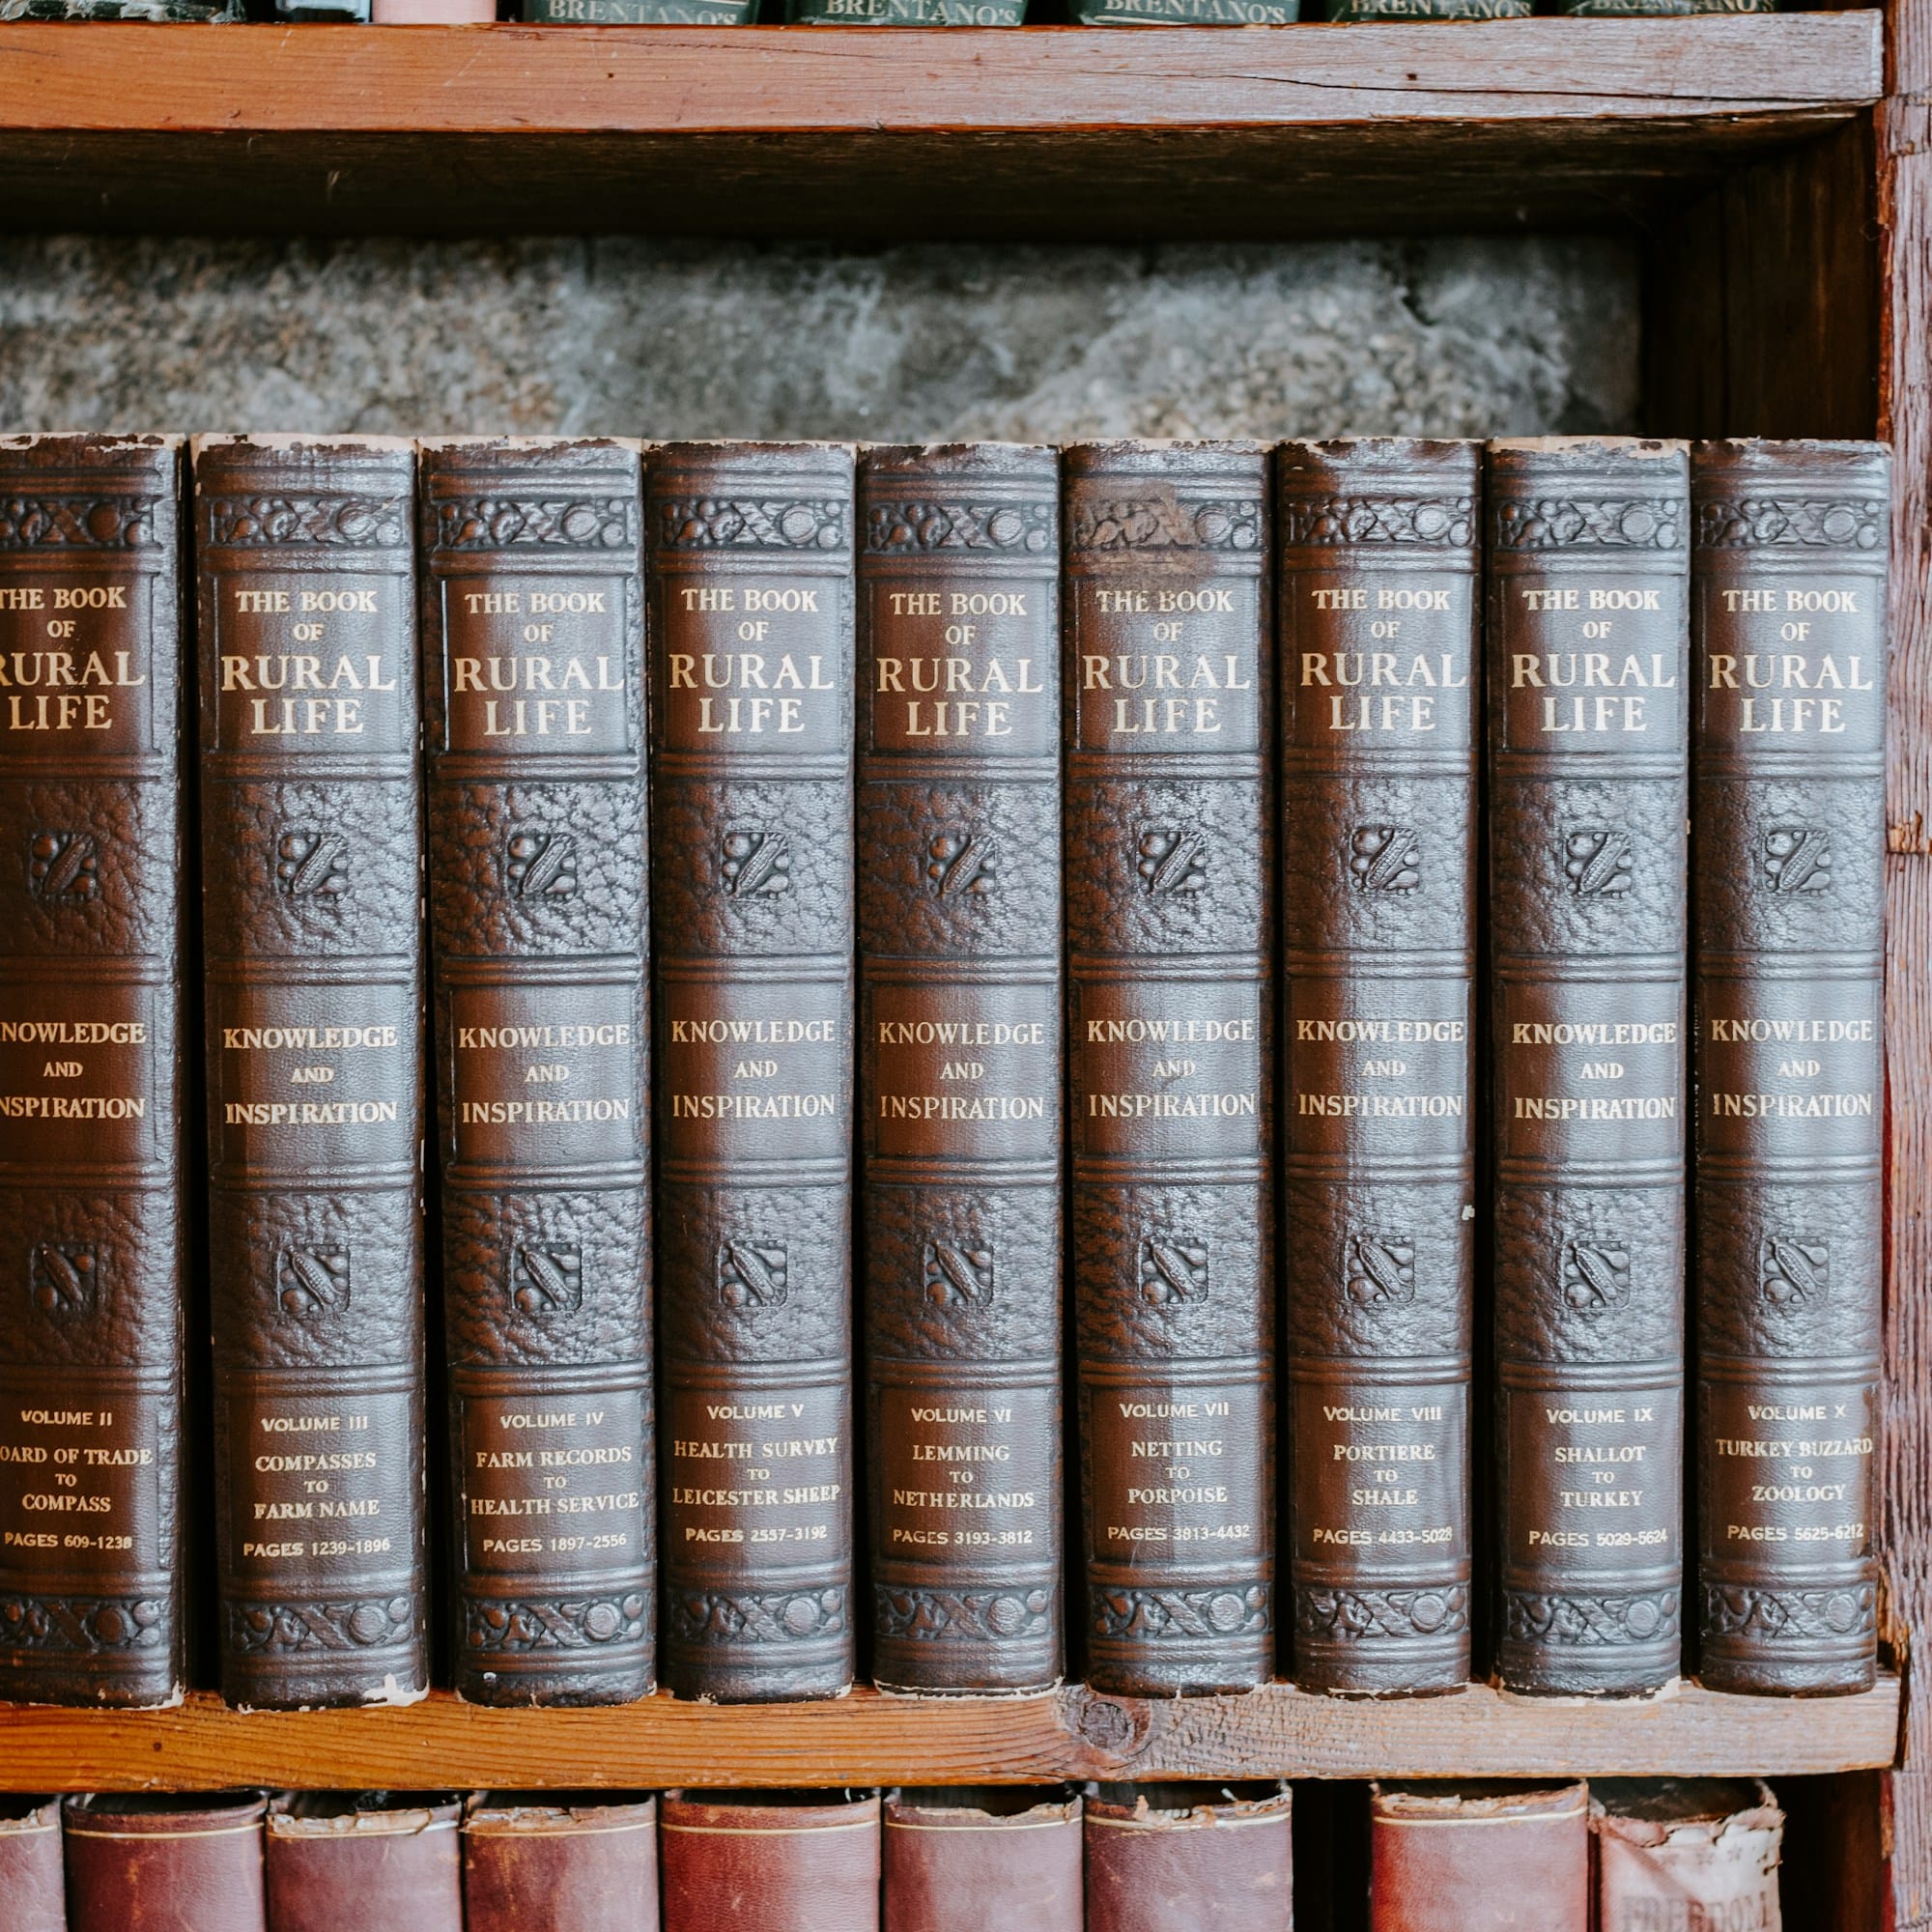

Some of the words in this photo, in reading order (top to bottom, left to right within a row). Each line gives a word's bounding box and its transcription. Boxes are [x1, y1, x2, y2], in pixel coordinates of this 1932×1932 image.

[0, 588, 44, 610] THE
[53, 586, 127, 609] BOOK
[236, 591, 290, 612] THE
[301, 590, 378, 612] BOOK
[465, 593, 520, 614] THE
[530, 591, 605, 613] BOOK
[681, 589, 734, 611] THE
[744, 589, 818, 612] BOOK
[890, 593, 942, 614] THE
[952, 594, 1027, 616] BOOK
[1095, 590, 1149, 611] THE
[1158, 589, 1234, 612] BOOK
[1312, 589, 1368, 611] THE
[1378, 589, 1451, 611] BOOK
[1522, 589, 1578, 611] THE
[1589, 589, 1660, 611] BOOK
[1721, 589, 1776, 611] THE
[1785, 590, 1857, 612] BOOK
[47, 620, 76, 638] OF
[294, 624, 323, 641] OF
[524, 624, 553, 641] OF
[739, 621, 768, 640] OF
[946, 625, 975, 645] OF
[1153, 622, 1182, 641] OF
[1371, 620, 1400, 639] OF
[1582, 621, 1612, 639] OF
[1781, 622, 1809, 641] OF
[220, 654, 396, 691] RURAL
[454, 656, 624, 692] RURAL
[669, 654, 834, 690] RURAL
[877, 657, 1043, 693] RURAL
[1082, 654, 1250, 690] RURAL
[1299, 652, 1467, 688] RURAL
[1511, 653, 1675, 689] RURAL
[1709, 654, 1873, 690] RURAL
[8, 695, 112, 729] LIFE
[251, 698, 364, 734] LIFE
[484, 699, 591, 735] LIFE
[698, 697, 806, 733] LIFE
[906, 700, 1012, 736] LIFE
[1114, 697, 1221, 733] LIFE
[1329, 695, 1435, 730] LIFE
[1541, 695, 1647, 731] LIFE
[1740, 697, 1845, 732] LIFE
[0, 1022, 147, 1043] NOWLEDGE
[223, 1027, 398, 1049] KNOWLEDGE
[459, 1024, 630, 1049] KNOWLEDGE
[671, 1020, 835, 1043] KNOWLEDGE
[879, 1022, 1044, 1045] KNOWLEDGE
[1087, 1019, 1255, 1042] KNOWLEDGE
[1296, 1019, 1464, 1042] KNOWLEDGE
[1512, 1022, 1677, 1045] KNOWLEDGE
[1711, 1019, 1872, 1042] KNOWLEDGE
[43, 1062, 83, 1077] AND
[290, 1066, 334, 1083] AND
[525, 1065, 569, 1082] AND
[734, 1061, 778, 1078] AND
[940, 1063, 983, 1080] AND
[1151, 1060, 1195, 1077] AND
[1362, 1060, 1406, 1077] AND
[1580, 1063, 1623, 1080] AND
[1777, 1060, 1820, 1077] AND
[0, 1096, 146, 1119] NSPIRATION
[225, 1101, 397, 1124] INSPIRATION
[462, 1099, 629, 1123] INSPIRATION
[672, 1094, 835, 1119] INSPIRATION
[880, 1095, 1044, 1120] INSPIRATION
[1089, 1093, 1255, 1118] INSPIRATION
[1298, 1094, 1463, 1117] INSPIRATION
[1515, 1096, 1676, 1120] INSPIRATION
[1712, 1093, 1872, 1118] INSPIRATION
[21, 1410, 93, 1426] VOLUME
[100, 1412, 112, 1426] II
[707, 1406, 784, 1419] VOLUME
[791, 1405, 804, 1417] V
[911, 1408, 986, 1422] VOLUME
[995, 1409, 1011, 1422] VI
[1120, 1404, 1198, 1418] VOLUME
[1206, 1402, 1229, 1416] VII
[1323, 1406, 1402, 1422] VOLUME
[1411, 1406, 1441, 1420] VIII
[1547, 1409, 1625, 1424] VOLUME
[1634, 1408, 1654, 1422] IX
[1747, 1406, 1826, 1420] VOLUME
[1835, 1406, 1846, 1417] X
[262, 1417, 340, 1432] VOLUME
[350, 1416, 368, 1430] III
[500, 1413, 576, 1429] VOLUME
[585, 1412, 604, 1426] IV
[0, 1446, 47, 1463] OARD
[54, 1449, 79, 1463] OF
[84, 1449, 154, 1464] TRADE
[674, 1440, 753, 1458] HEALTH
[762, 1437, 838, 1458] SURVEY
[913, 1445, 1009, 1462] LEMMING
[1132, 1440, 1222, 1457] NETTING
[1334, 1444, 1435, 1461] PORTIERE
[1555, 1446, 1646, 1463] SHALLOT
[1716, 1439, 1794, 1457] TURKEY
[1799, 1437, 1873, 1457] BUZZARD
[255, 1452, 377, 1471] COMPASSES
[476, 1452, 533, 1467] FARM
[540, 1447, 632, 1466] RECORDS
[55, 1474, 77, 1487] TO
[748, 1468, 770, 1480] TO
[950, 1471, 973, 1483] TO
[1166, 1466, 1190, 1479] TO
[1374, 1470, 1398, 1483] TO
[1592, 1471, 1615, 1484] TO
[1790, 1466, 1812, 1479] TO
[304, 1480, 328, 1492] TO
[544, 1476, 566, 1489] TO
[672, 1488, 779, 1506] LEICESTER
[783, 1485, 841, 1504] SHEEP
[894, 1490, 1034, 1508] NETHERLANDS
[1128, 1487, 1228, 1504] PORPOISE
[1352, 1490, 1419, 1506] SHALE
[1561, 1491, 1643, 1507] TURKEY
[1751, 1484, 1846, 1501] ZOOLOGY
[22, 1494, 111, 1512] COMPASS
[254, 1502, 313, 1520] FARM
[320, 1500, 380, 1518] NAME
[471, 1499, 551, 1516] HEALTH
[557, 1492, 639, 1513] SERVICE
[5, 1532, 58, 1547] PAGES
[65, 1535, 132, 1549] 609-1238
[686, 1528, 743, 1542] PAGES
[751, 1526, 827, 1542] 2557-3192
[894, 1529, 949, 1545] PAGES
[954, 1530, 1033, 1545] 3193-3812
[1108, 1527, 1167, 1541] PAGES
[1173, 1524, 1250, 1540] 3813-4432
[1313, 1529, 1372, 1545] PAGES
[1378, 1527, 1452, 1544] 4433-5028
[1529, 1531, 1589, 1546] PAGES
[1597, 1529, 1668, 1546] 5029-5624
[1727, 1525, 1787, 1541] PAGES
[1794, 1524, 1863, 1541] 5625-6212
[243, 1543, 303, 1557] PAGES
[312, 1538, 391, 1556] 1239-1896
[483, 1539, 542, 1552] PAGES
[551, 1534, 627, 1550] 1897-2556
